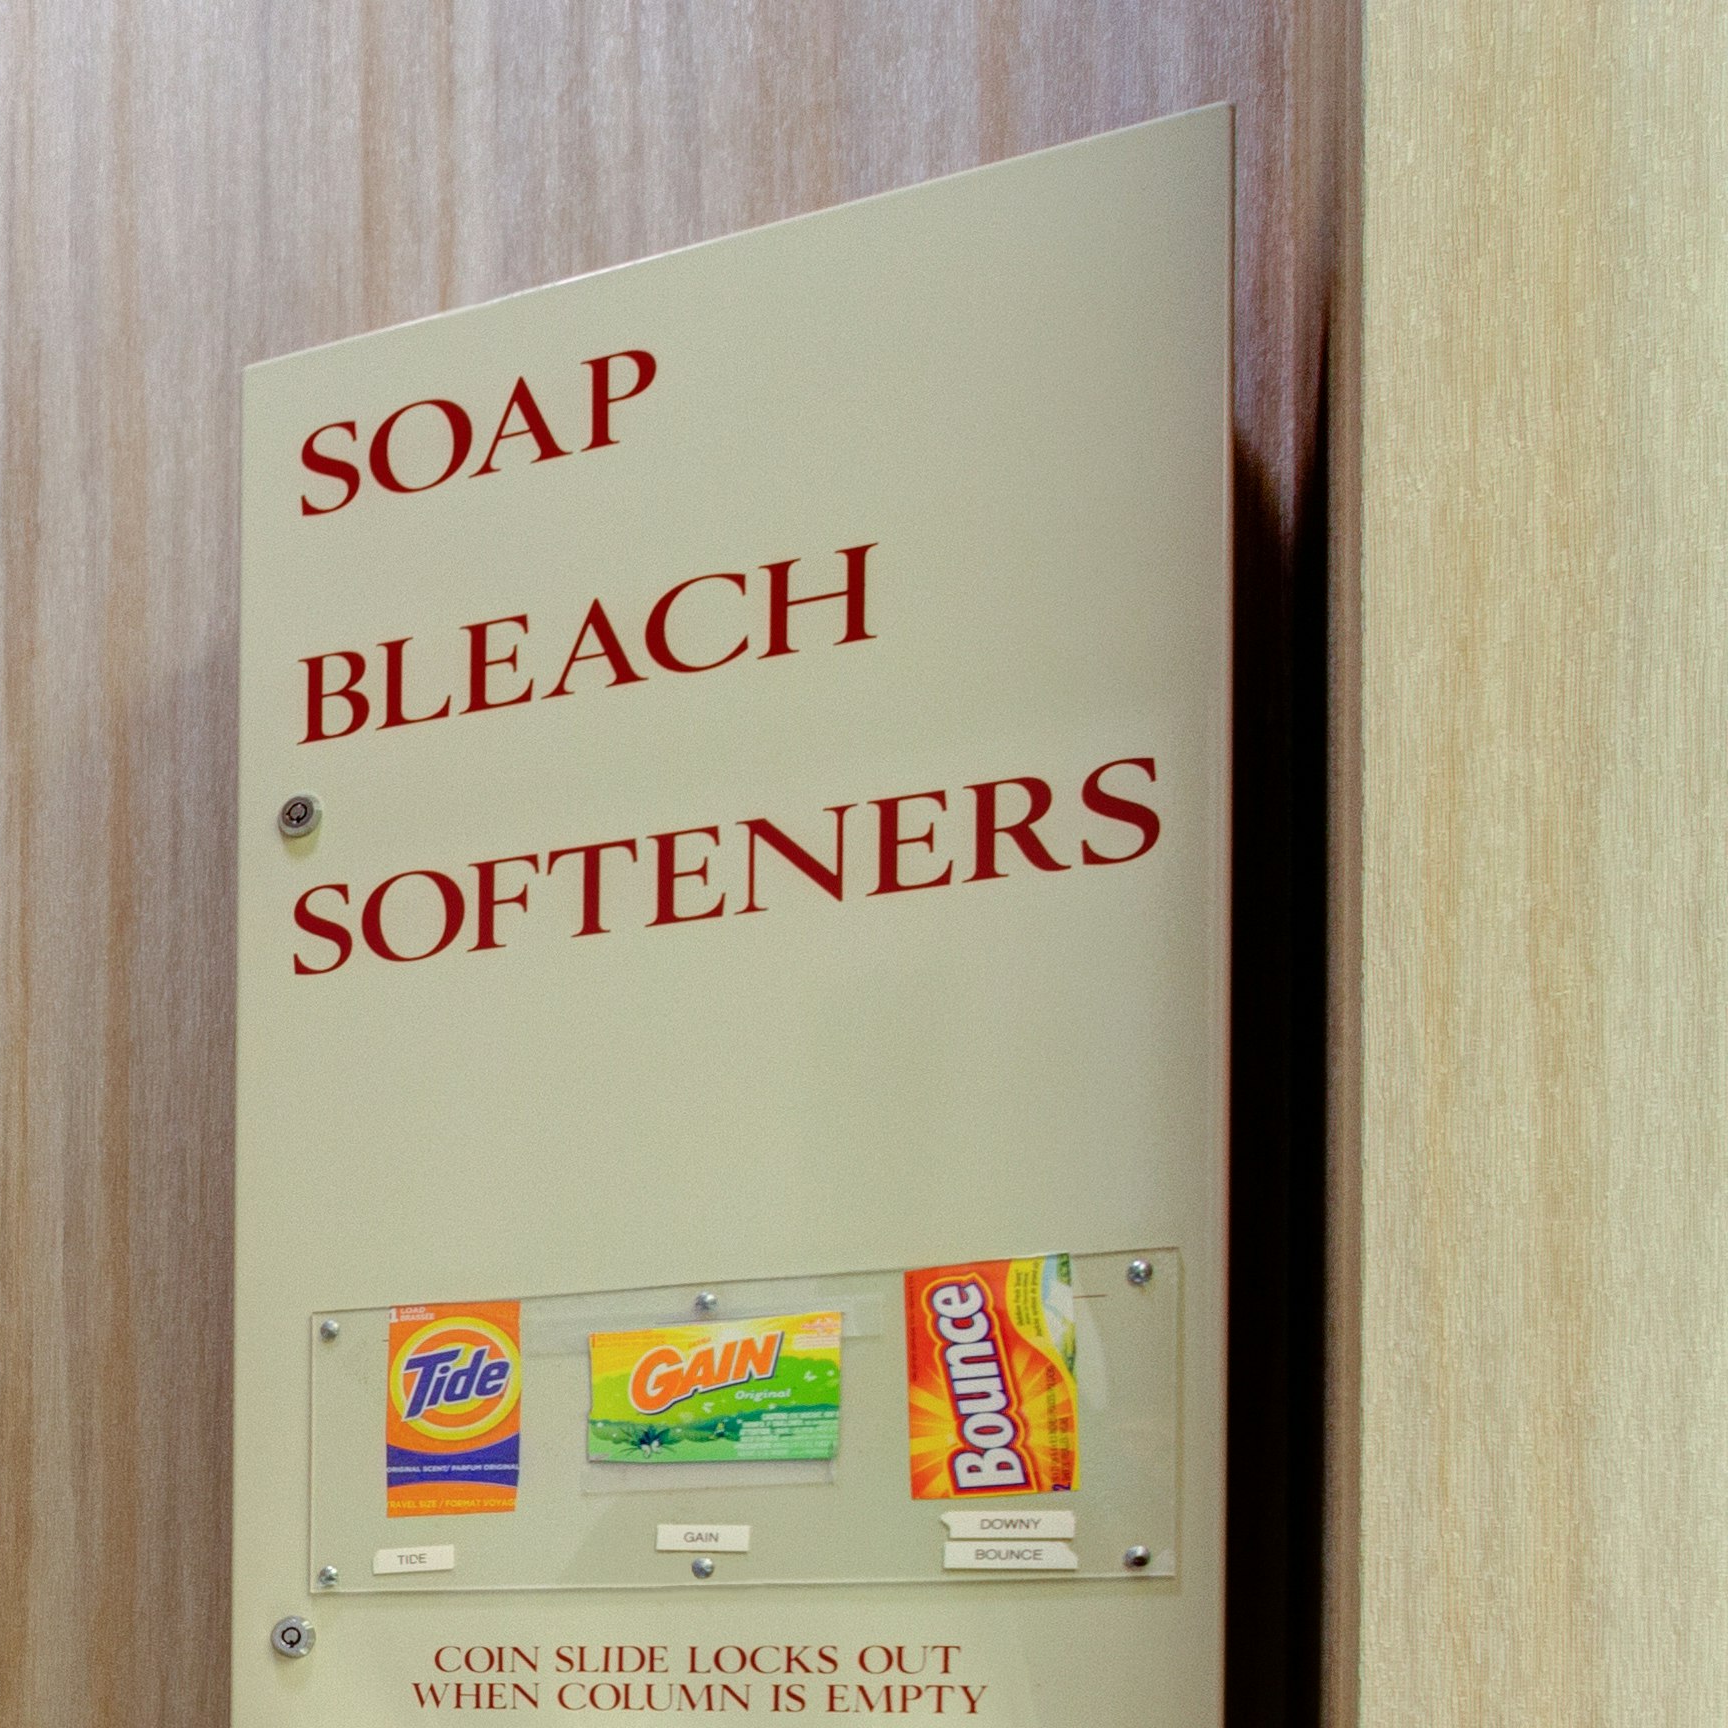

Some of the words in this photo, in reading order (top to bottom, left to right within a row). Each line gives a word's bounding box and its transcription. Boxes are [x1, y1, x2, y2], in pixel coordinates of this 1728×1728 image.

[299, 349, 657, 516] SOAP
[296, 542, 880, 745] BLEACH
[291, 757, 1162, 976] SOFTENERS
[403, 1346, 511, 1422] Tide
[629, 1332, 783, 1413] GAIN
[932, 1282, 1026, 1488] Bounce
[735, 1388, 792, 1403] Original
[683, 1531, 719, 1543] GAIN
[980, 1518, 1042, 1530] DOWNY
[397, 1553, 427, 1566] TIDE
[975, 1549, 1044, 1561] BOUNCE
[434, 1645, 540, 1674] COIN
[554, 1645, 669, 1674] SLIDE
[688, 1645, 839, 1675] LOCKS
[857, 1645, 962, 1675] OUT
[411, 1682, 540, 1711] WHEN
[557, 1682, 751, 1713] COLUMN
[770, 1683, 806, 1713] IS
[825, 1684, 988, 1715] EMPTY
